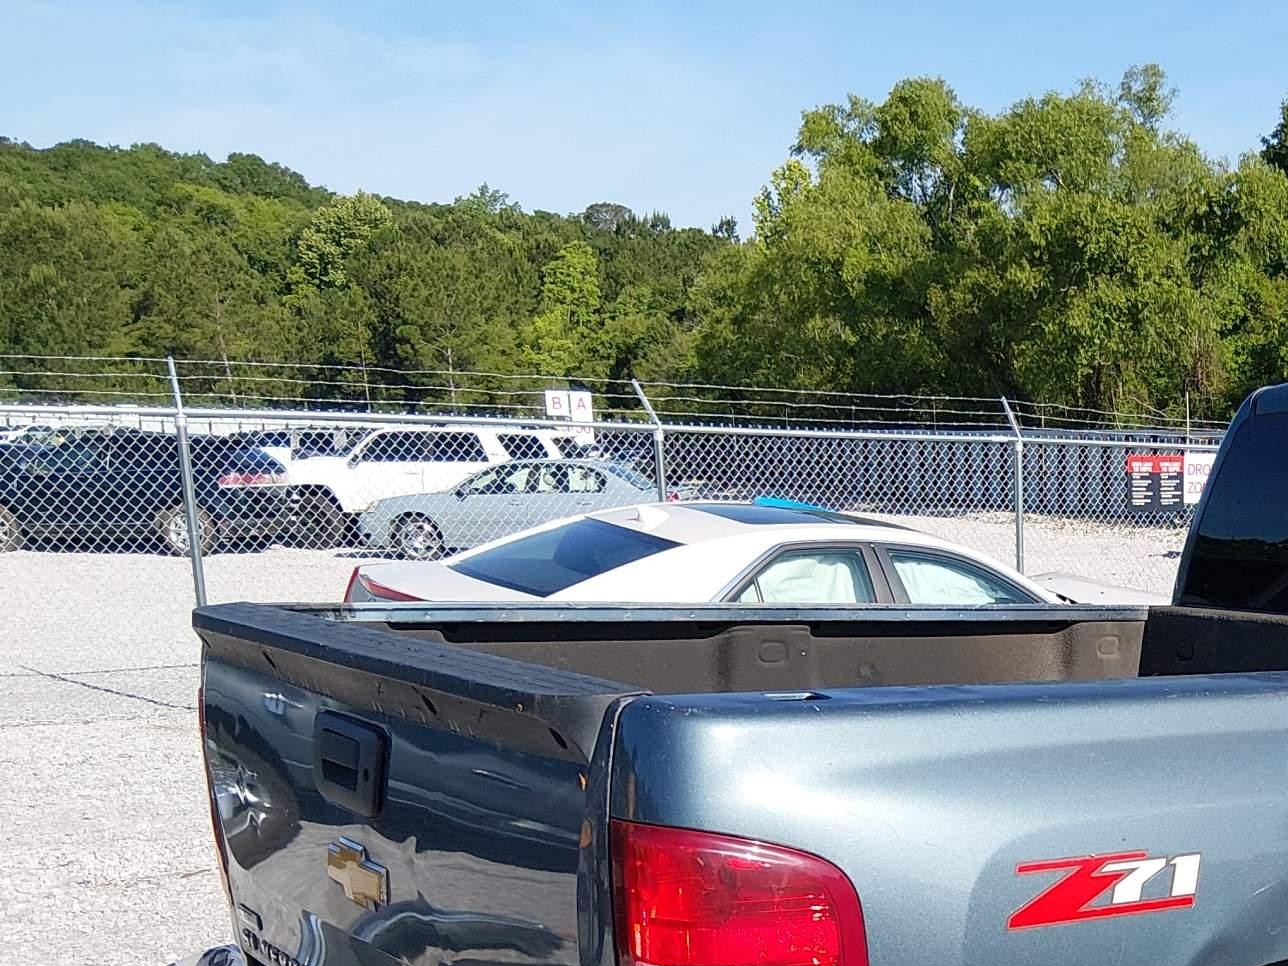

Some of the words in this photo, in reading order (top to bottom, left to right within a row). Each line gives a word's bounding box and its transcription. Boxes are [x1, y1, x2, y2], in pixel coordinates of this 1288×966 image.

[551, 396, 562, 410] B
[577, 397, 587, 410] A
[1187, 463, 1212, 477] DRO
[1006, 848, 1202, 932] Z71
